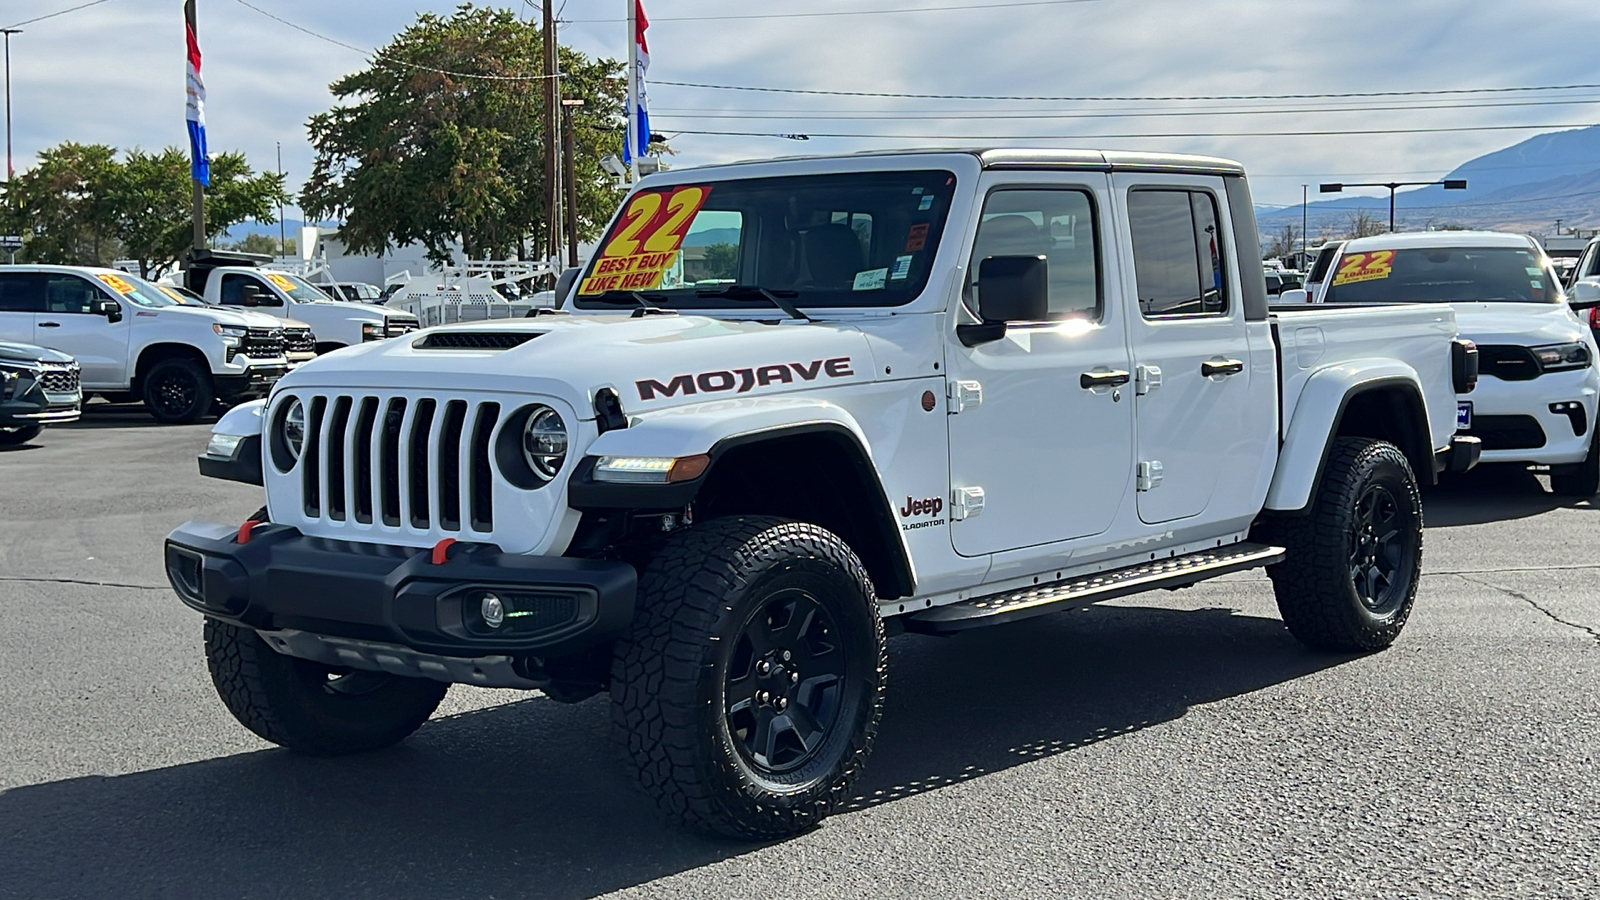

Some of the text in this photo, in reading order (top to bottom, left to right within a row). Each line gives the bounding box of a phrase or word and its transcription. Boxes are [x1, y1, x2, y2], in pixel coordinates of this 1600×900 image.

[604, 187, 703, 257] 22
[597, 253, 673, 275] BEST BUY
[1340, 251, 1393, 273] 22
[1344, 268, 1384, 278] LOADED
[584, 276, 619, 294] LIKE
[620, 271, 660, 289] NEW
[635, 357, 854, 401] MOJAVE
[901, 495, 943, 517] Jeep
